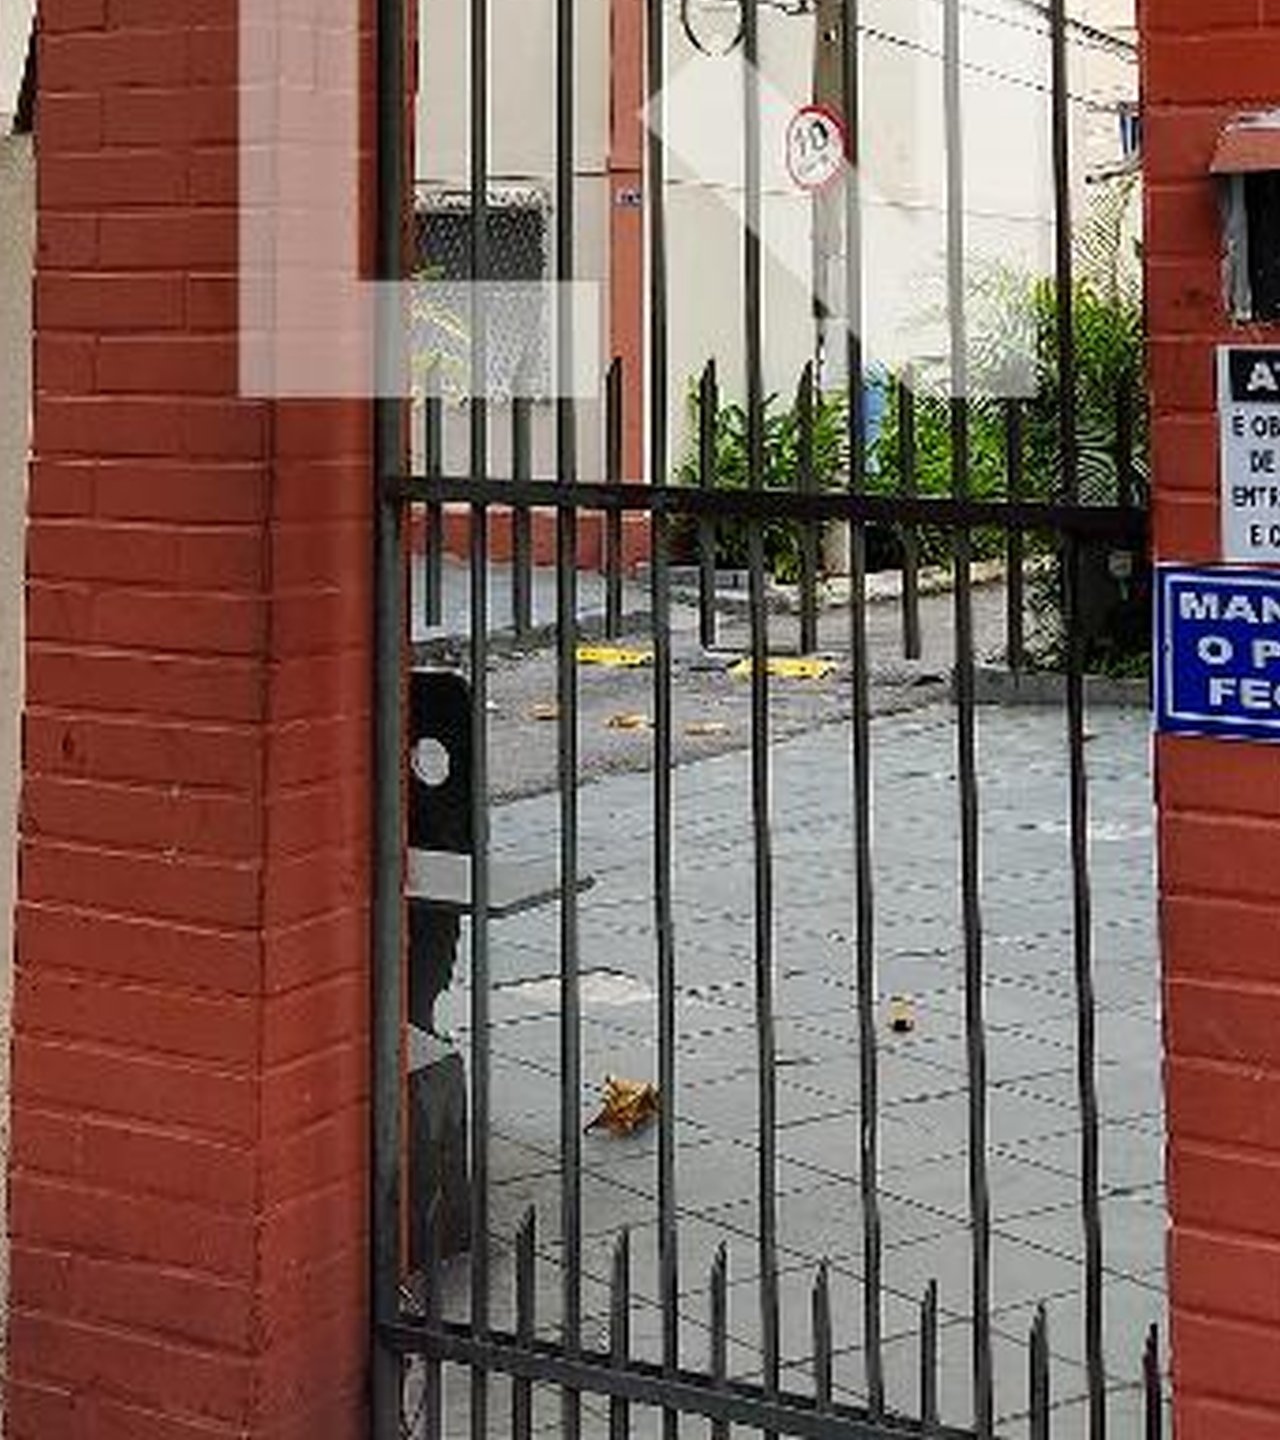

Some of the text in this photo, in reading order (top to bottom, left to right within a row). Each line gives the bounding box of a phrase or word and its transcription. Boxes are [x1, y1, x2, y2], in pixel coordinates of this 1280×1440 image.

[1250, 449, 1275, 474] DE
[1250, 524, 1262, 547] E
[1197, 635, 1233, 665] O
